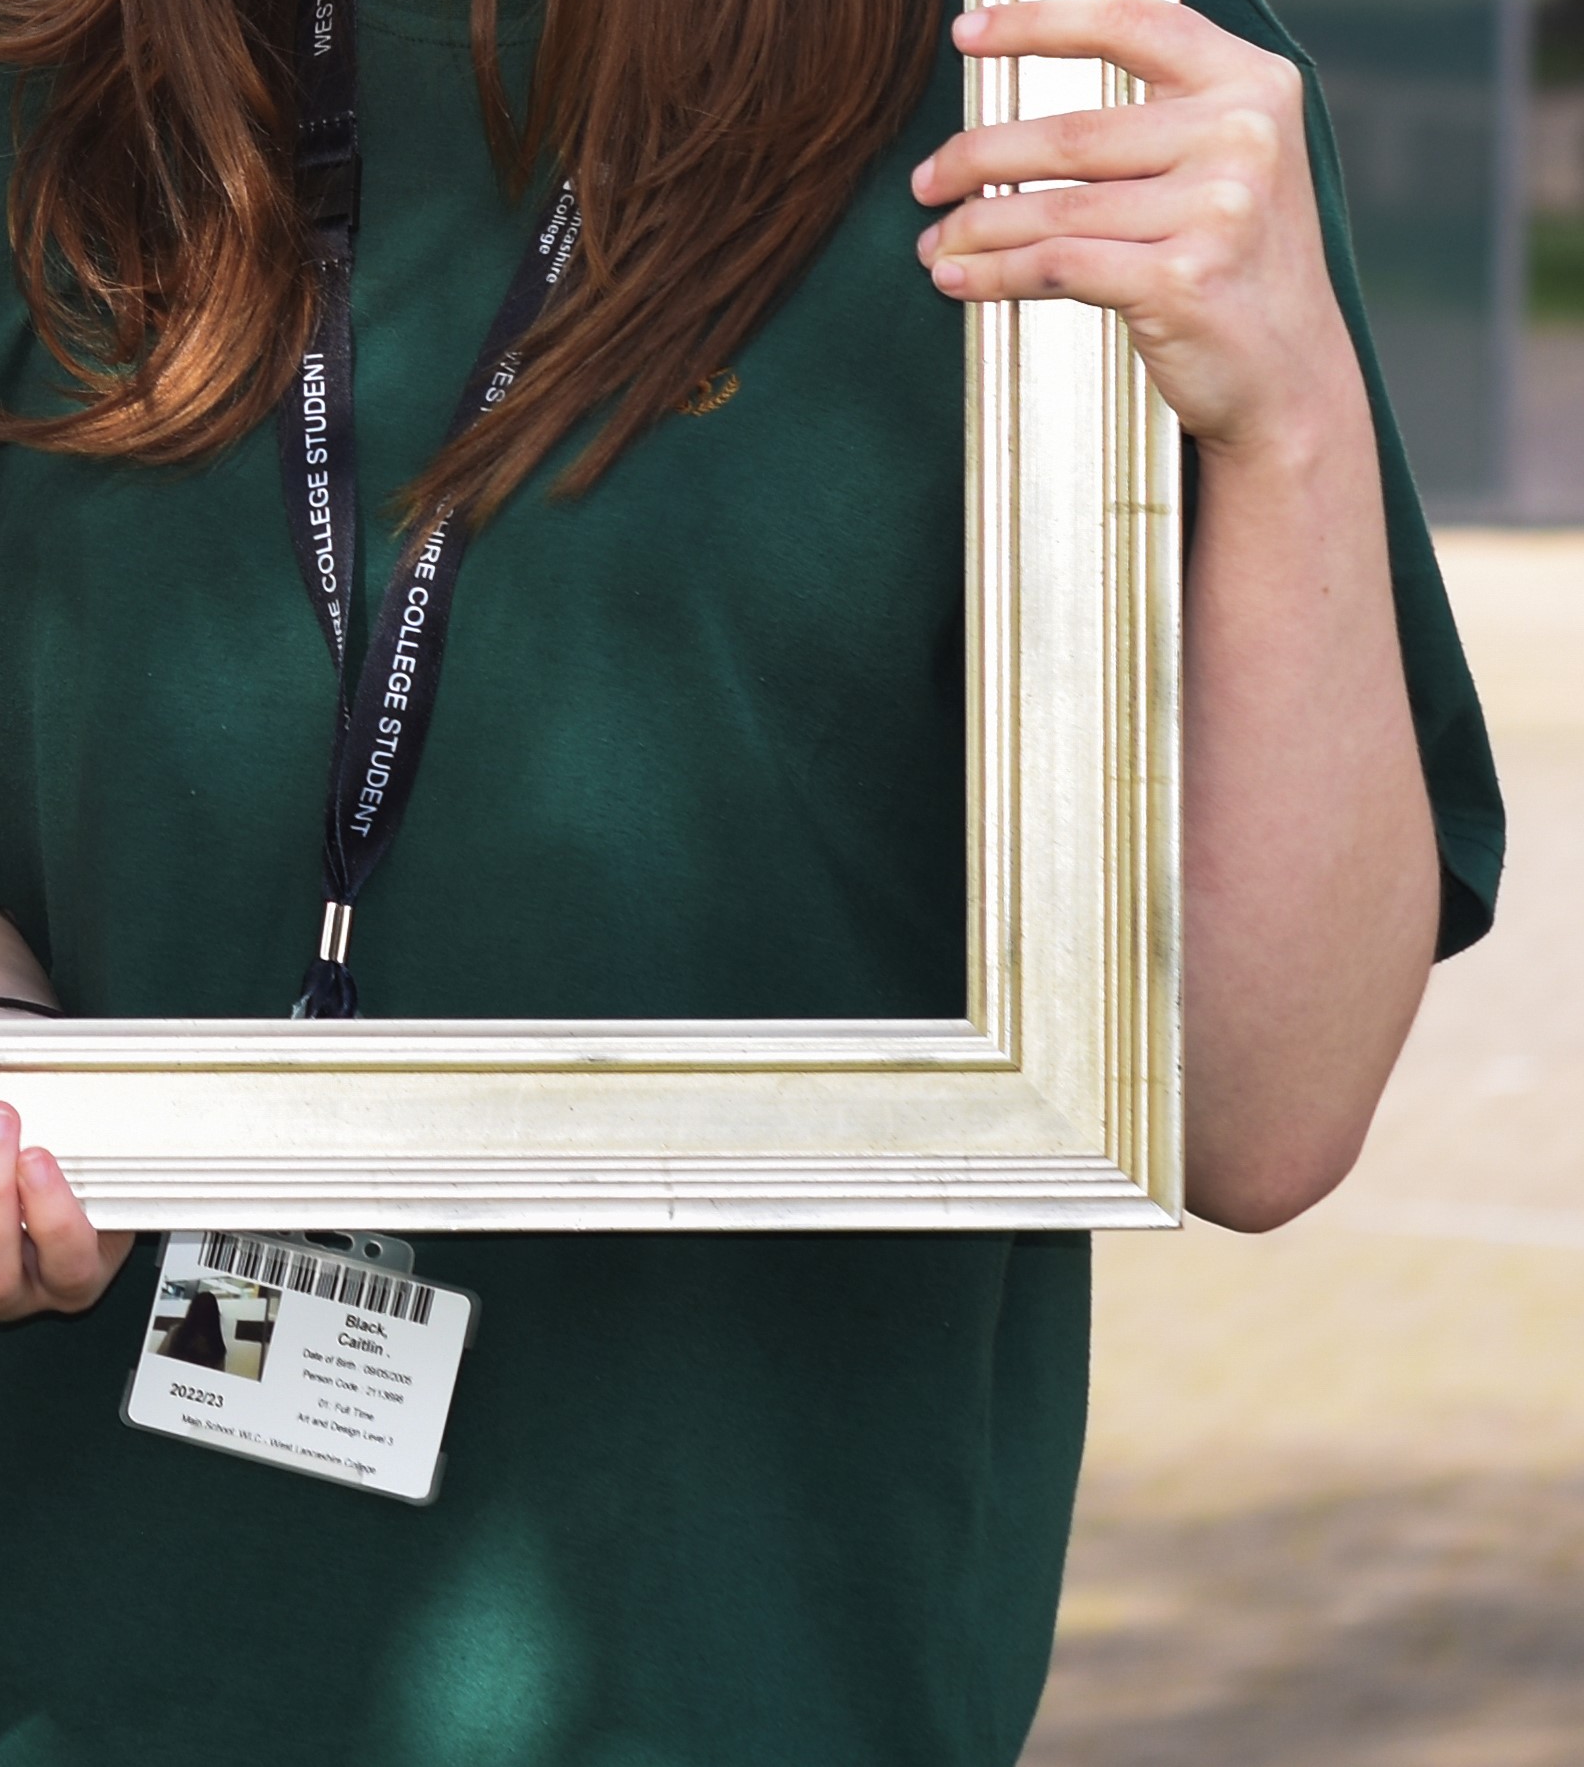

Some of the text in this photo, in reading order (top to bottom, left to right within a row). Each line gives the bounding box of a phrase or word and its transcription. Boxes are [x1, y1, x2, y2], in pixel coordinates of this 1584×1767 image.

[539, 194, 575, 255] College
[546, 209, 582, 283] ncashire
[303, 352, 328, 465] STUDENT
[307, 470, 337, 593] COLLEGE
[350, 586, 429, 838] COLLEGE STUDENT
[337, 1332, 384, 1356] Caitlin
[345, 1313, 388, 1339] Black,
[169, 1383, 225, 1408] 2022/23
